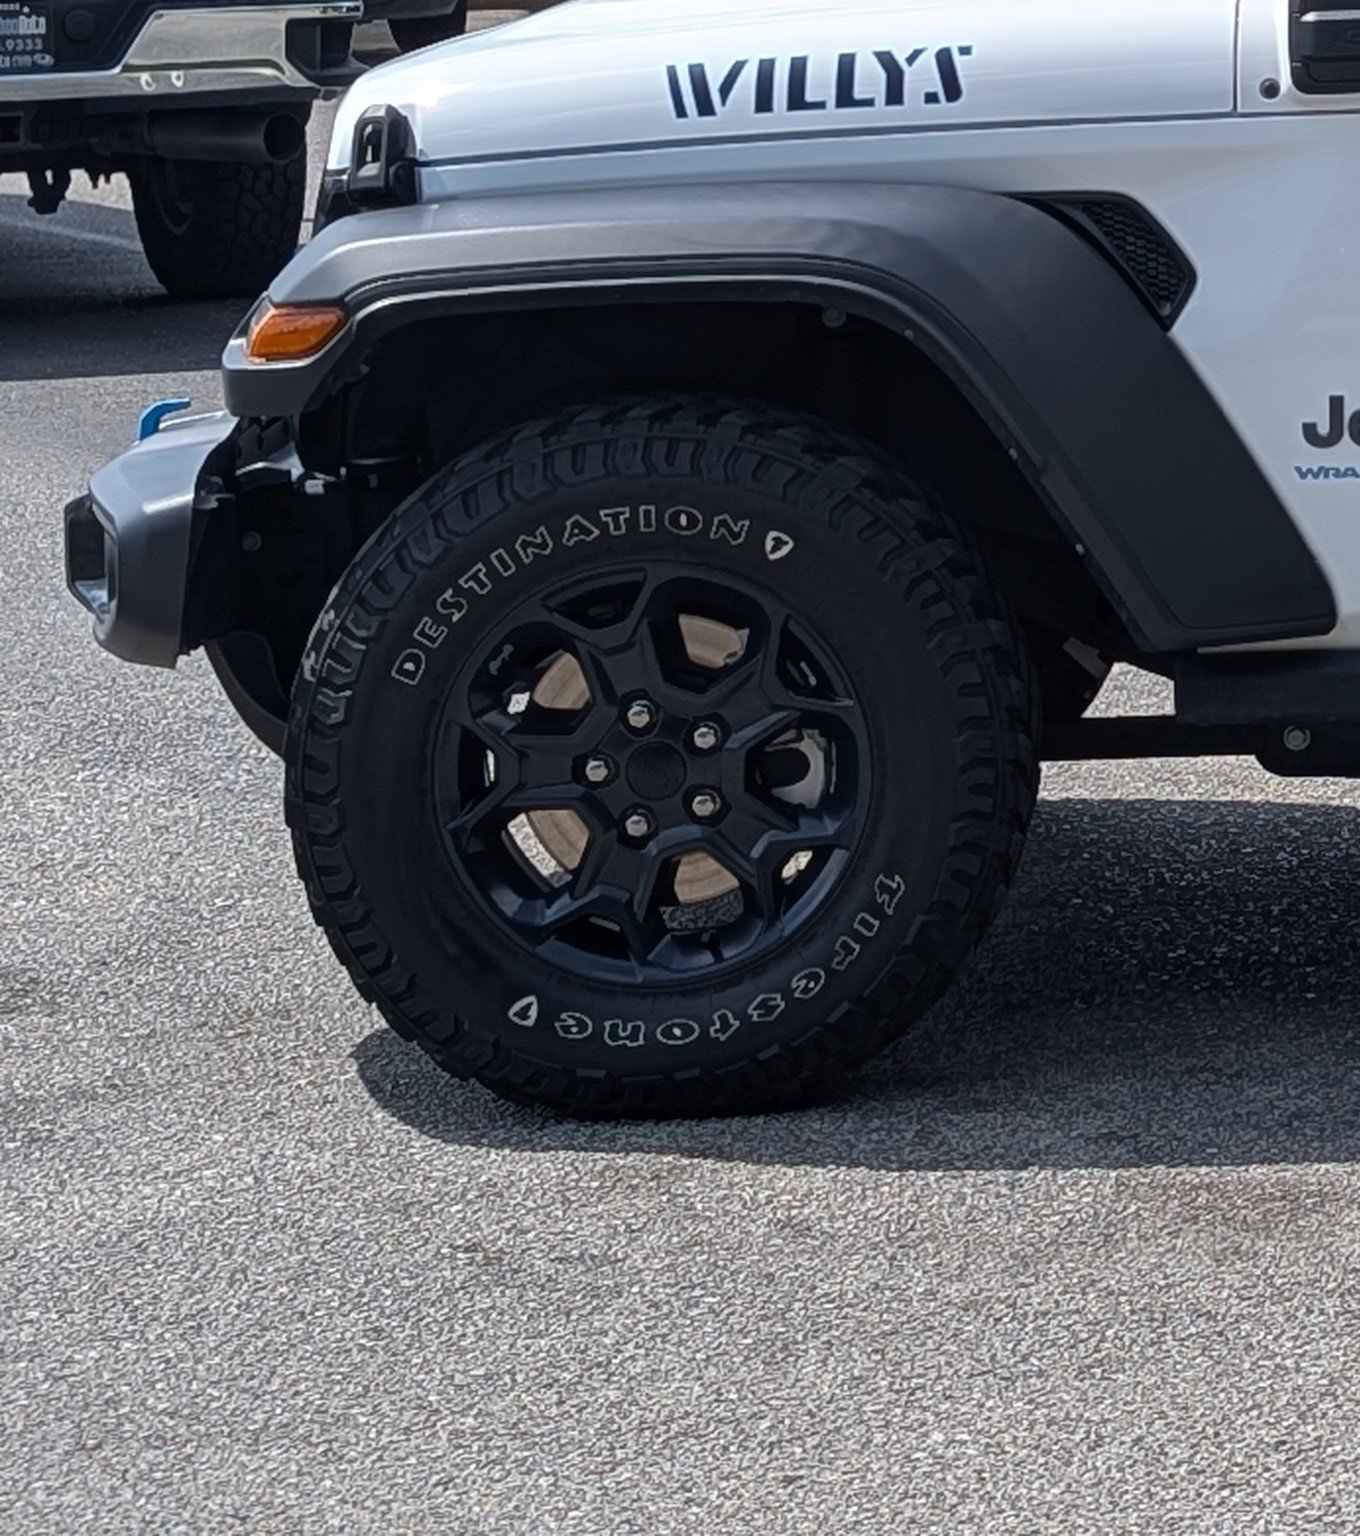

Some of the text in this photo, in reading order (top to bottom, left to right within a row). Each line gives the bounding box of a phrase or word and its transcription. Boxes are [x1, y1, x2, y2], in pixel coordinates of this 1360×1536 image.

[665, 45, 973, 119] WILLYS
[392, 505, 750, 685] DESTINATION
[554, 872, 906, 1047] Firestone
